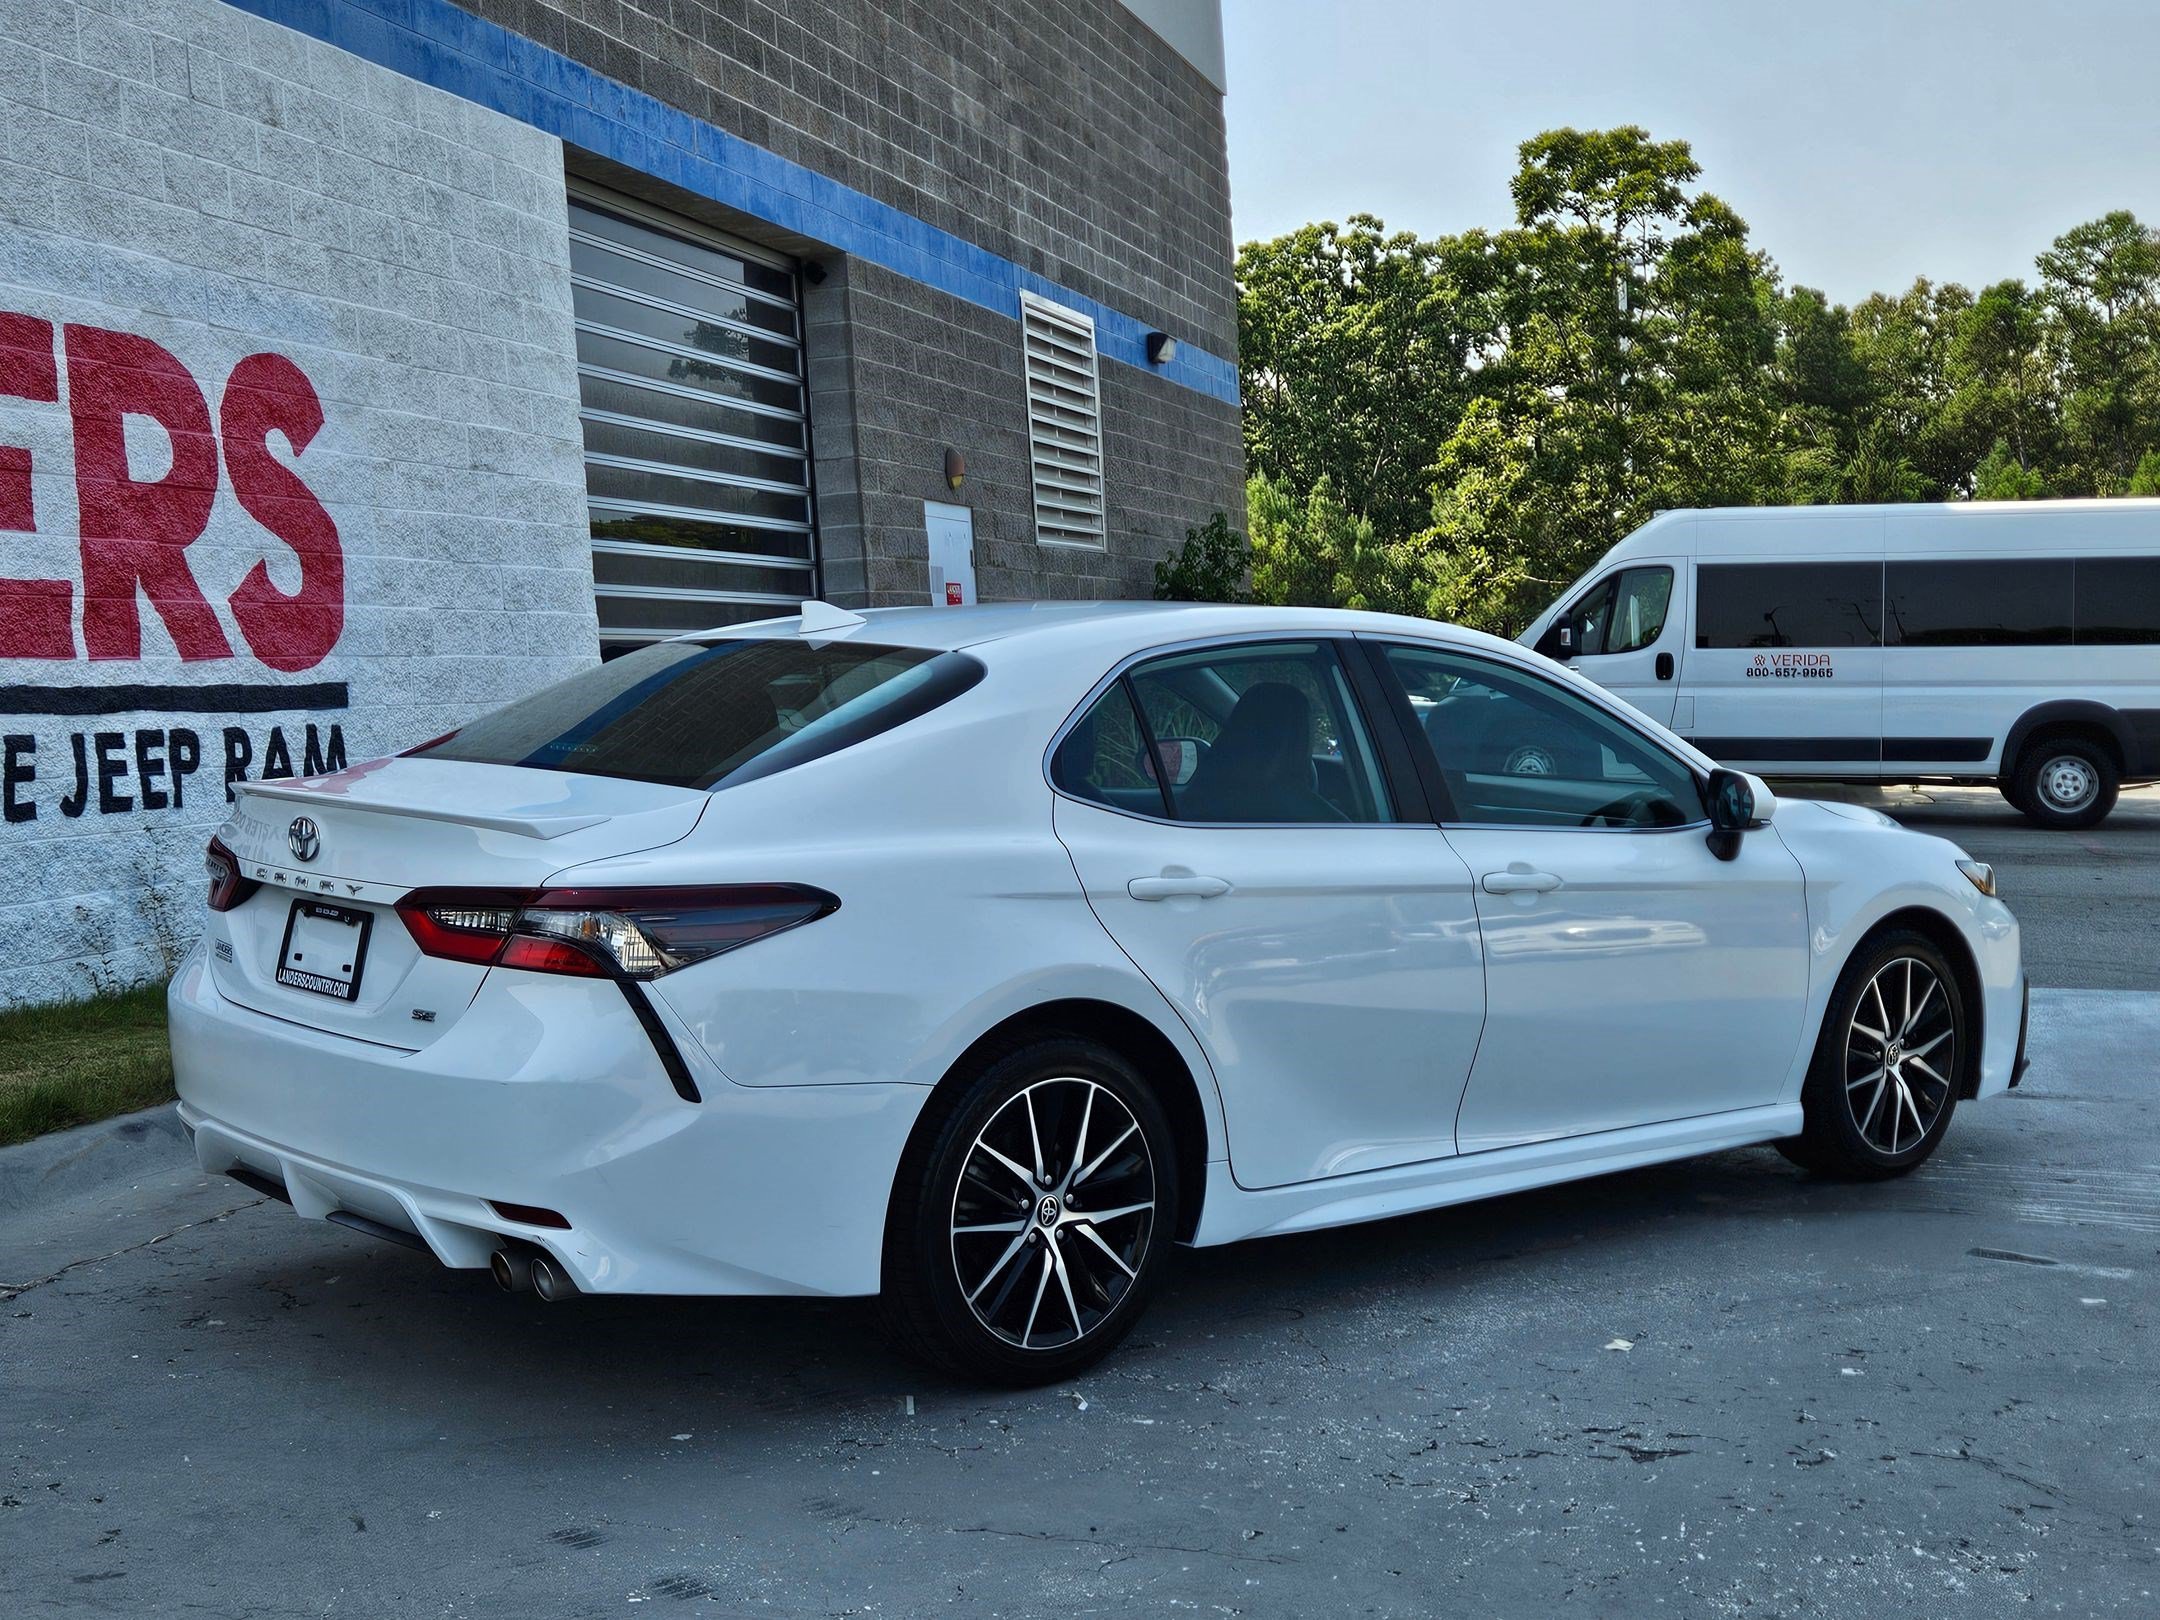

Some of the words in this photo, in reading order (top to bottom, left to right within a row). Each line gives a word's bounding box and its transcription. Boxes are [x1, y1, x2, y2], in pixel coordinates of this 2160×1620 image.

[1770, 654, 1830, 666] VERIDA
[60, 728, 200, 818] JEEP
[223, 724, 347, 802] RAM
[256, 867, 364, 896] CAMRY
[277, 967, 350, 998] LANDERSCOUNTRY.COM
[411, 1009, 436, 1022] SE
